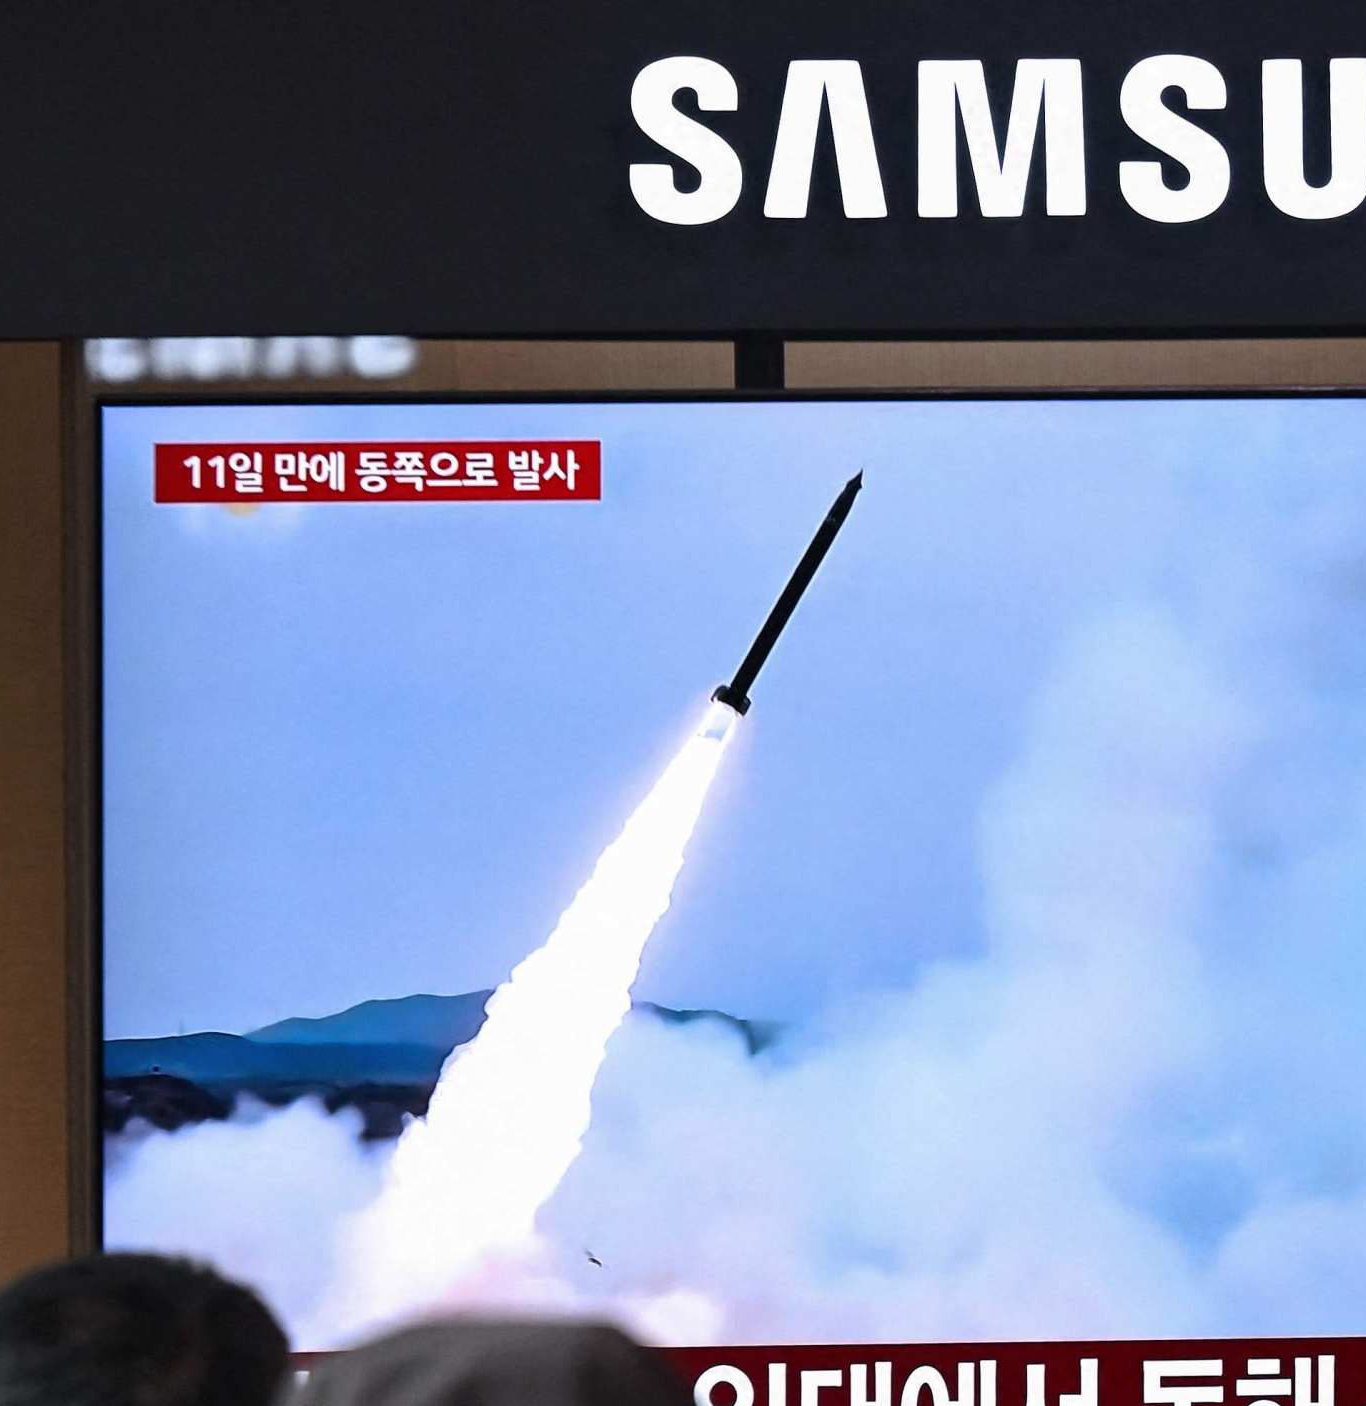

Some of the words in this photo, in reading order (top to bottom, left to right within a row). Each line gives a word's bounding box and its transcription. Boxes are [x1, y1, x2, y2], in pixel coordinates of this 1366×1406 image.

[183, 451, 264, 493] 11일
[274, 451, 346, 492] 만에
[354, 451, 499, 493] 동쪽으로
[508, 449, 580, 491] 발사
